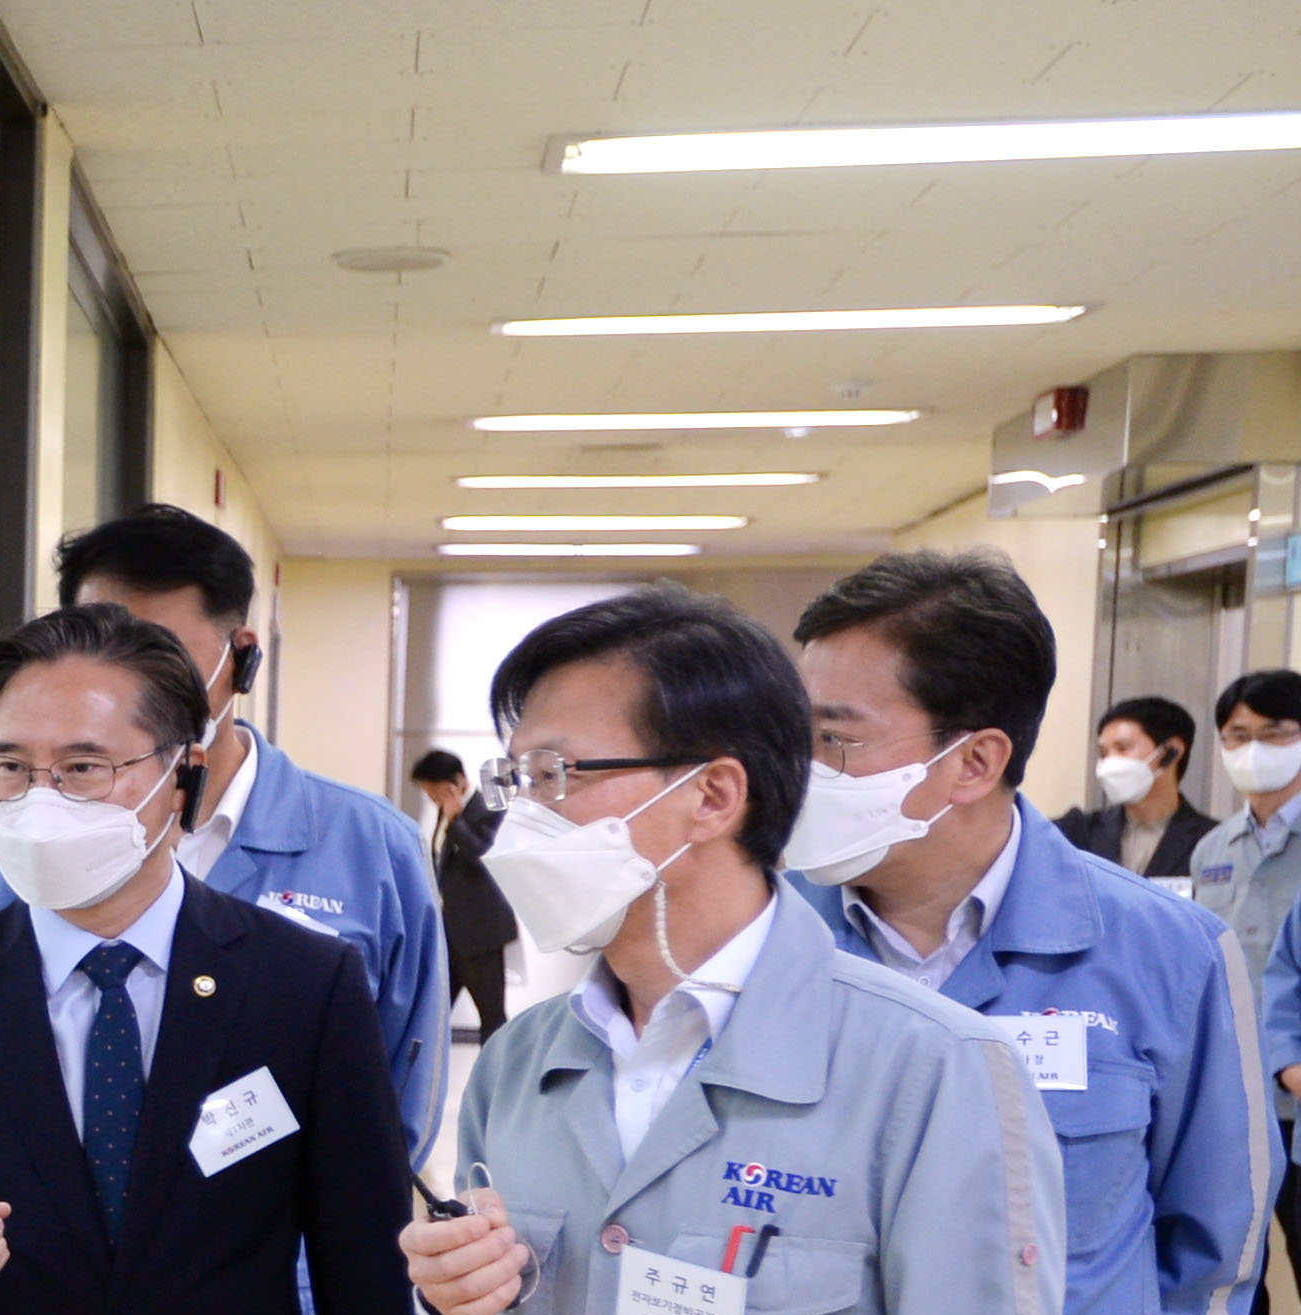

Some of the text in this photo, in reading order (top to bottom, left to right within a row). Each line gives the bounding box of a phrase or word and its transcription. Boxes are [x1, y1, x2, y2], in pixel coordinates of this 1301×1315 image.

[269, 890, 343, 914] KOREAN
[1016, 1029, 1060, 1047] 수근
[1038, 1072, 1059, 1080] AIR
[221, 1125, 275, 1157] KOREAN AIR
[722, 1161, 838, 1198] KOREAN
[721, 1186, 776, 1214] AIR
